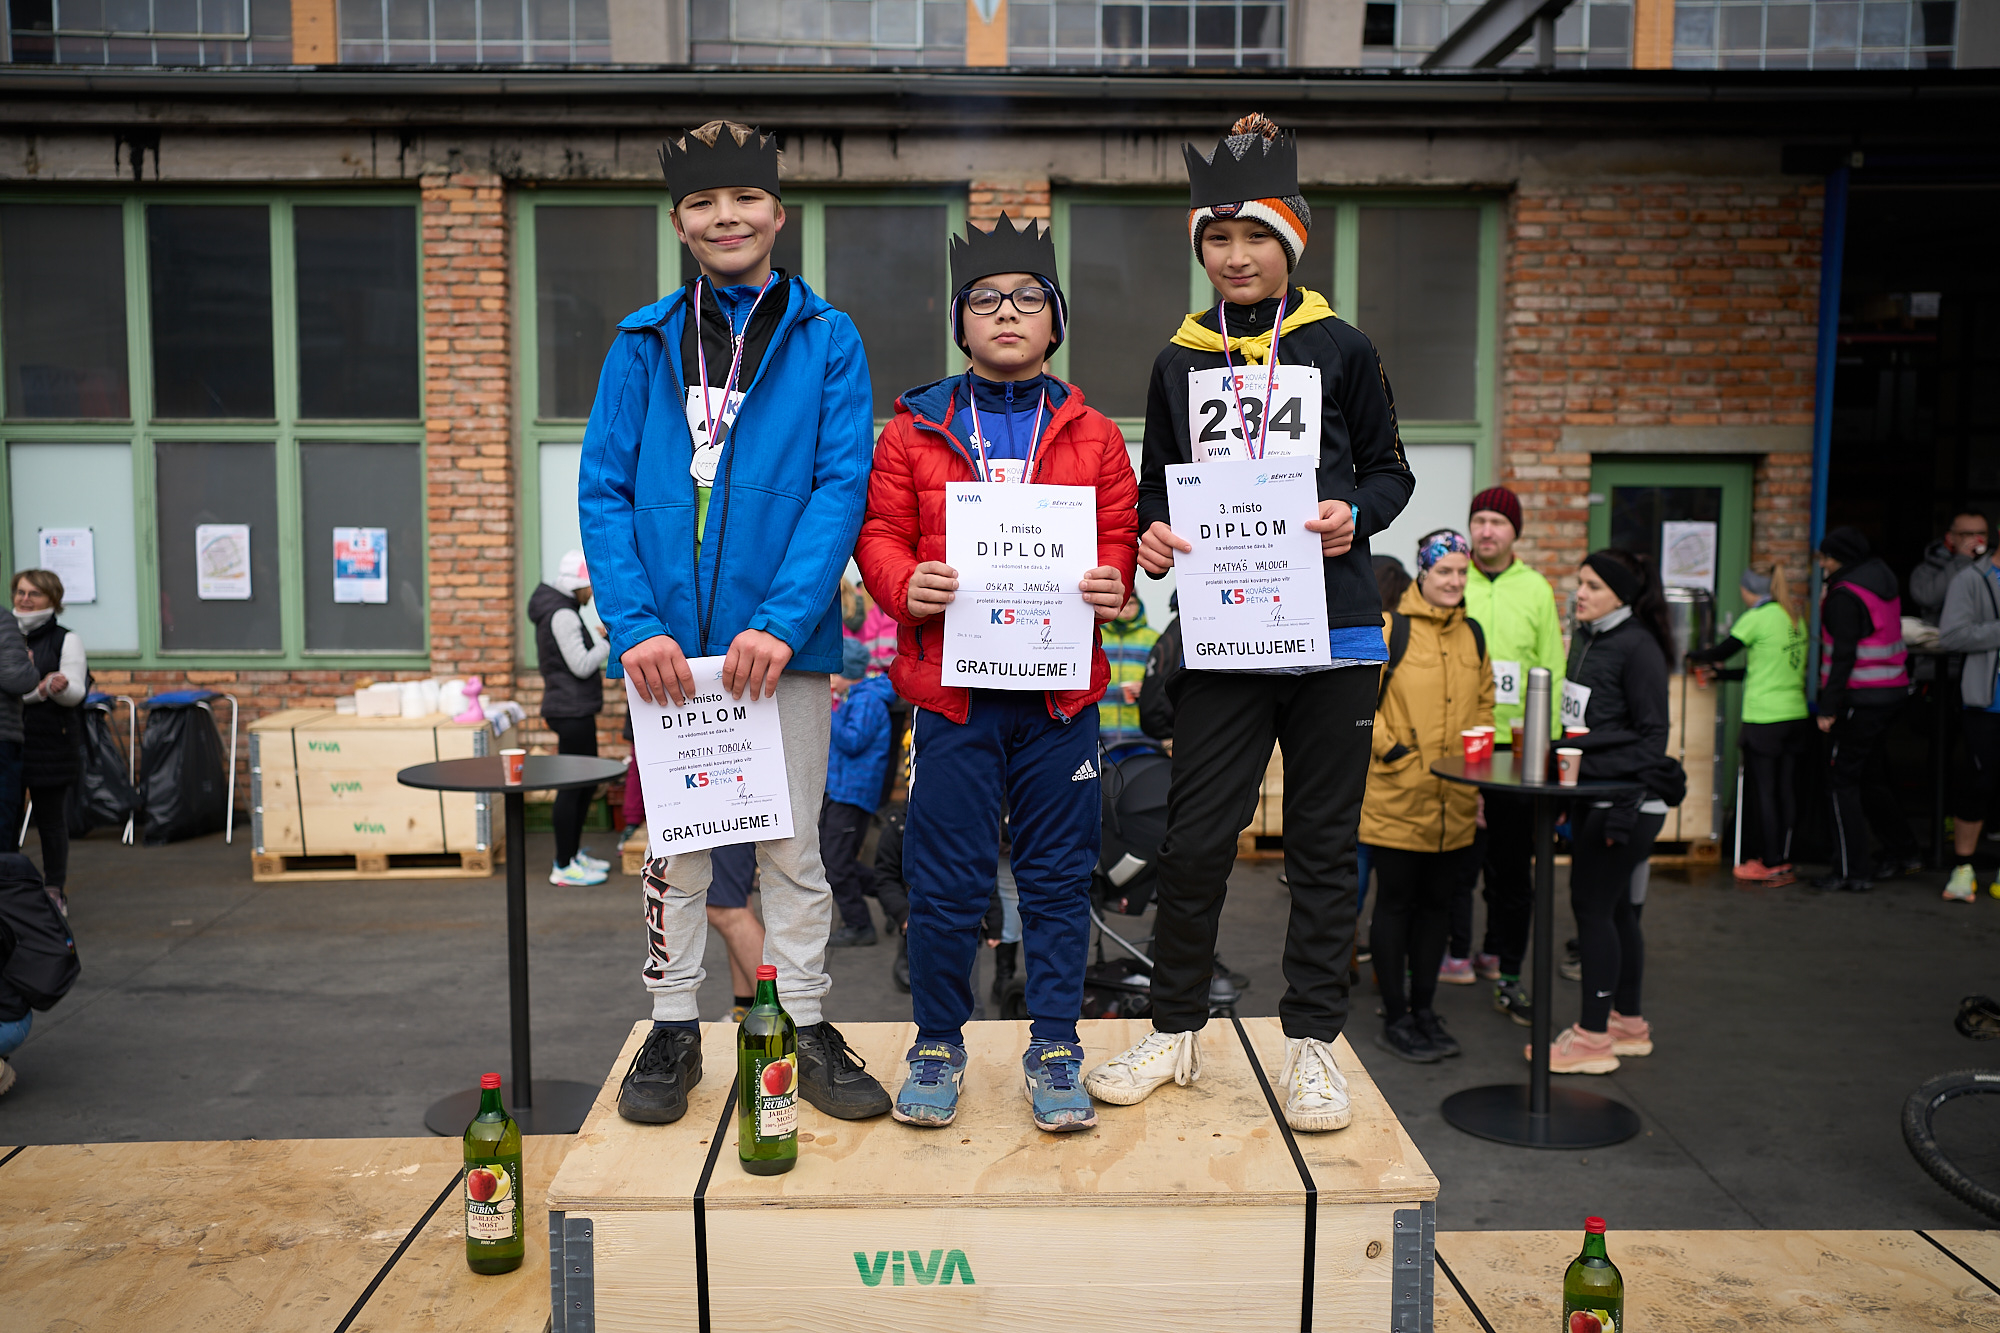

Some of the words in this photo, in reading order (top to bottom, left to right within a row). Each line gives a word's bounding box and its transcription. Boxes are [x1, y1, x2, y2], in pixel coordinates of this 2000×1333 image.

[1199, 397, 1306, 443] 234
[1219, 504, 1229, 514] 3.
[1232, 502, 1262, 514] místo
[999, 523, 1008, 533] 1.
[1011, 523, 1042, 534] místo
[1200, 519, 1287, 539] DIPLOM
[977, 541, 1064, 558] DIPLOM
[1213, 558, 1248, 573] MATYÁŠ
[1255, 560, 1288, 571] VALOUCH
[985, 582, 1014, 591] OSKAR
[1022, 580, 1060, 592] JANUŠKA
[1245, 586, 1280, 595] KOVÁŘSKÁ
[1220, 588, 1245, 605] K5
[1246, 596, 1269, 604] PĚTKA
[990, 608, 1015, 625] K5
[1016, 608, 1051, 617] KOVÁŘSKÁ
[1016, 617, 1039, 625] PĚTKA
[1196, 639, 1306, 656] GRATULUJEME
[1310, 638, 1315, 652] !
[956, 659, 1068, 677] GRATULUJEME
[1072, 662, 1077, 676] !
[693, 693, 723, 705] místo
[661, 705, 747, 730] DIPLOM
[678, 746, 713, 759] MARTIN
[718, 738, 752, 753] TOBOLÁK
[709, 767, 743, 777] KOVÁŘSKÁ
[1071, 771, 1098, 782] adidas
[684, 771, 710, 789] K5
[710, 777, 733, 786] PĚTKA
[662, 814, 770, 842] GRATULUJEME
[774, 813, 779, 826] !
[763, 1097, 791, 1109] RUBÍN
[469, 1205, 495, 1214] RUBÍN
